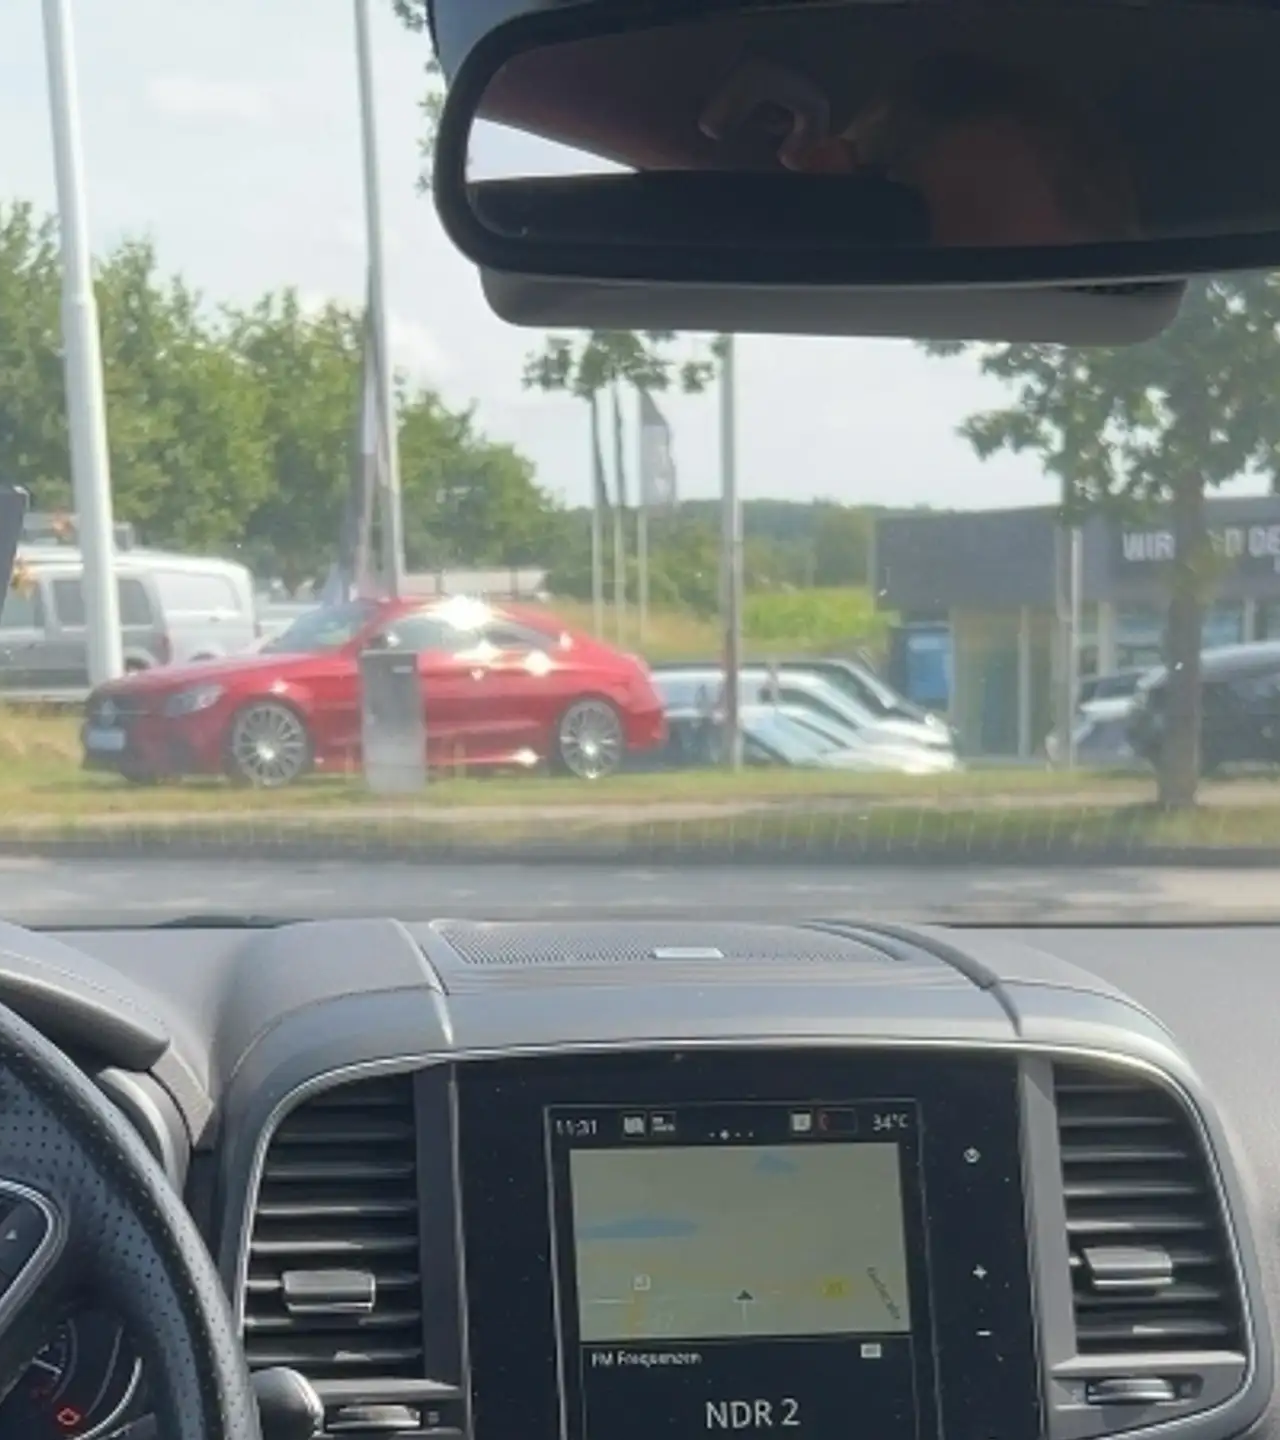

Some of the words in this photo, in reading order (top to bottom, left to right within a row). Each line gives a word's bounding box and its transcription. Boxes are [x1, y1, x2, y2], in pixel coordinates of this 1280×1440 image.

[1122, 531, 1175, 561] WIR
[705, 1400, 774, 1430] NDR
[781, 1398, 800, 1427] 2
